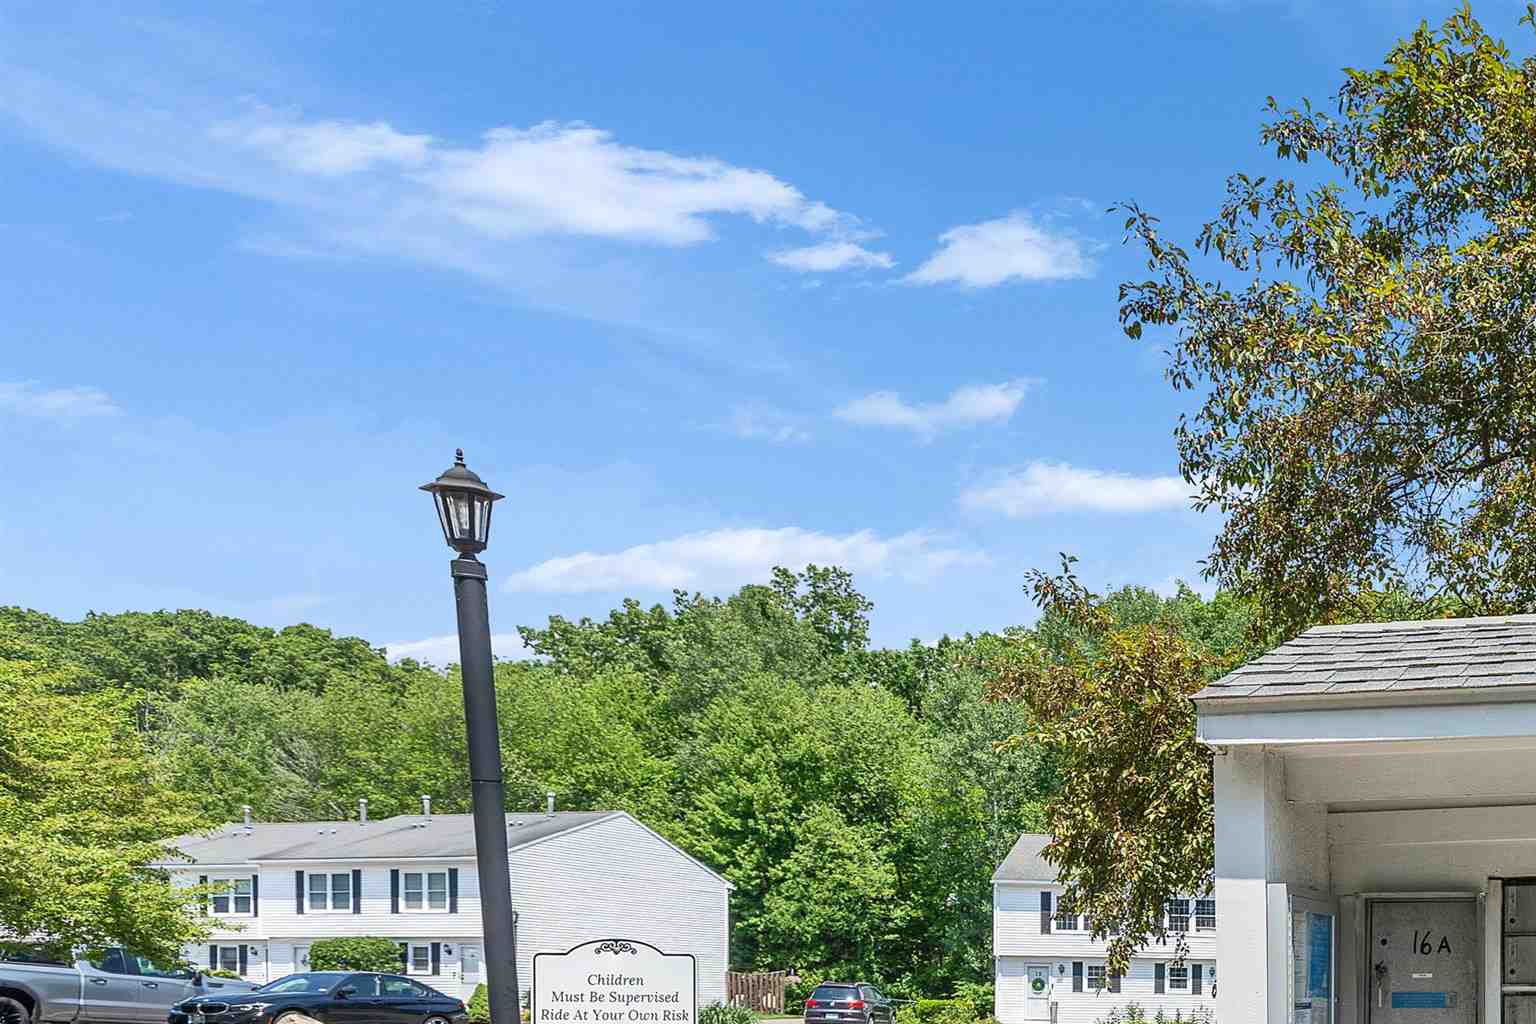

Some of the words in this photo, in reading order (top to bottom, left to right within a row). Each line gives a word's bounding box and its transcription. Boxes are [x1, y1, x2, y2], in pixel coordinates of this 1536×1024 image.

[588, 974, 644, 986] Children
[551, 991, 584, 1003] Must
[590, 991, 605, 1003] Be
[609, 991, 679, 1006] Supervised
[541, 1009, 569, 1021] Ride
[573, 1009, 588, 1021] At
[593, 1009, 624, 1021] Your
[628, 1009, 659, 1021] Own
[663, 1009, 689, 1021] Risk
